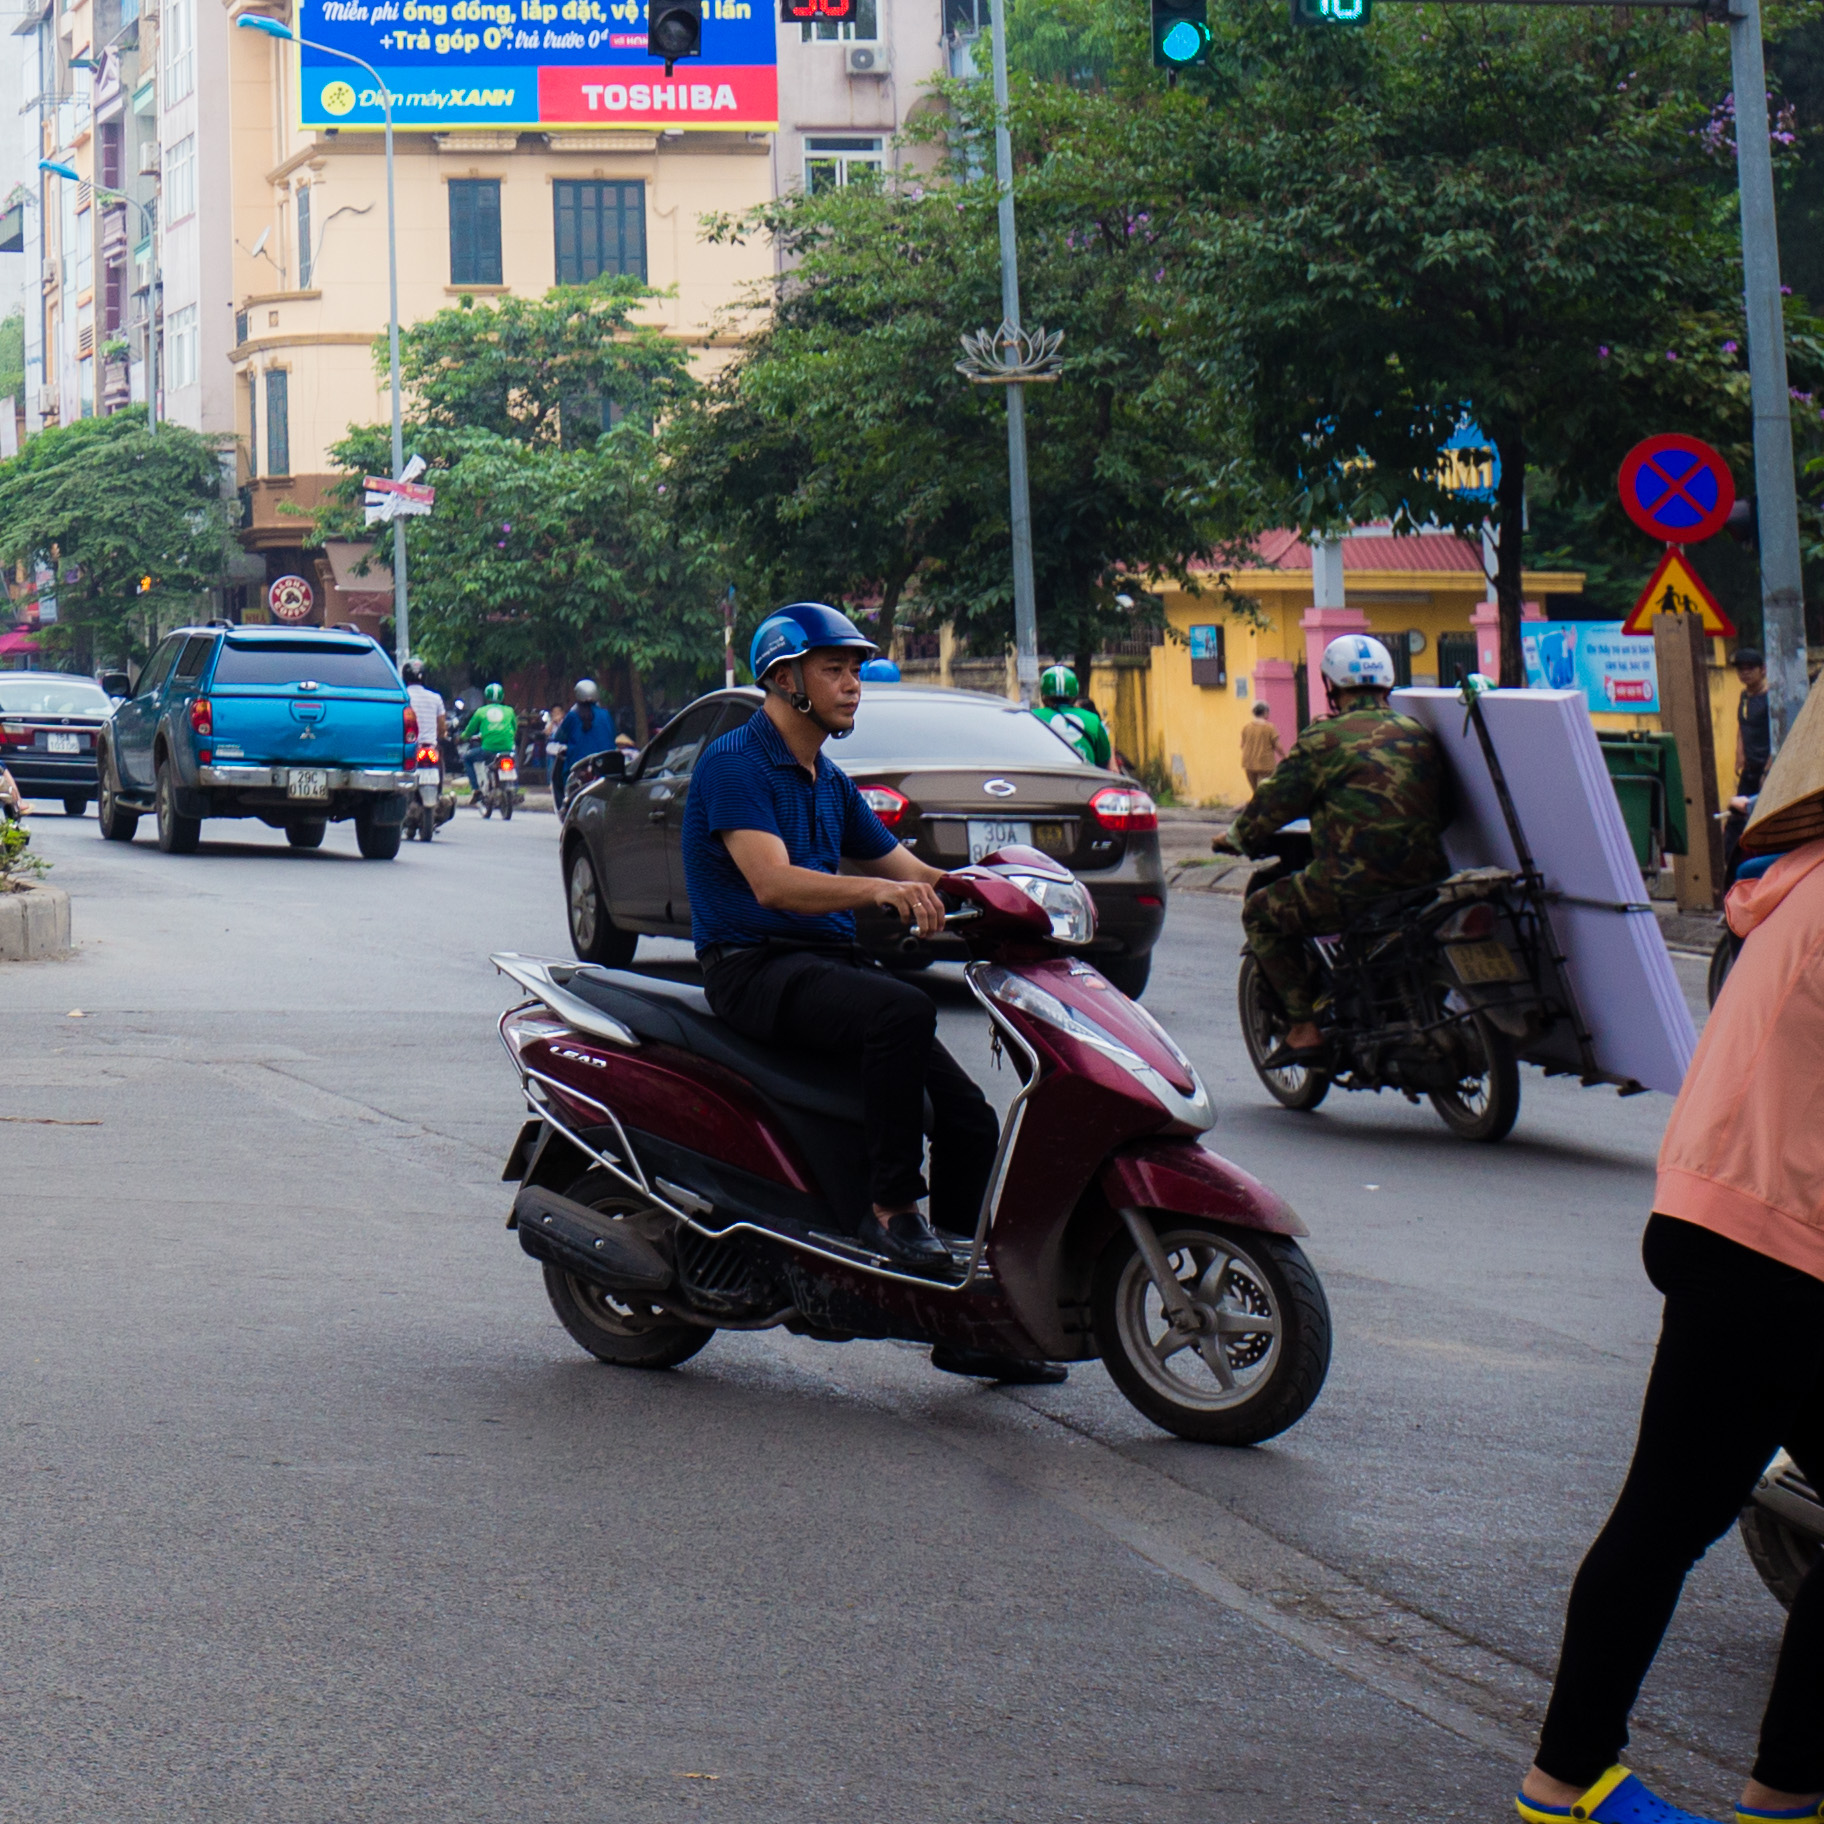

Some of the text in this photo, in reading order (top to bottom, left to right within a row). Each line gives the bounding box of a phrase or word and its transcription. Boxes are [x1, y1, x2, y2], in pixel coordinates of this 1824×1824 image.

[322, 0, 369, 22] Miễn
[403, 0, 447, 26] ống
[380, 29, 432, 50] +Trả
[436, 30, 477, 55] góp
[582, 84, 738, 111] TOSHIBA
[297, 771, 319, 784] 29C
[984, 822, 1018, 844] 30A
